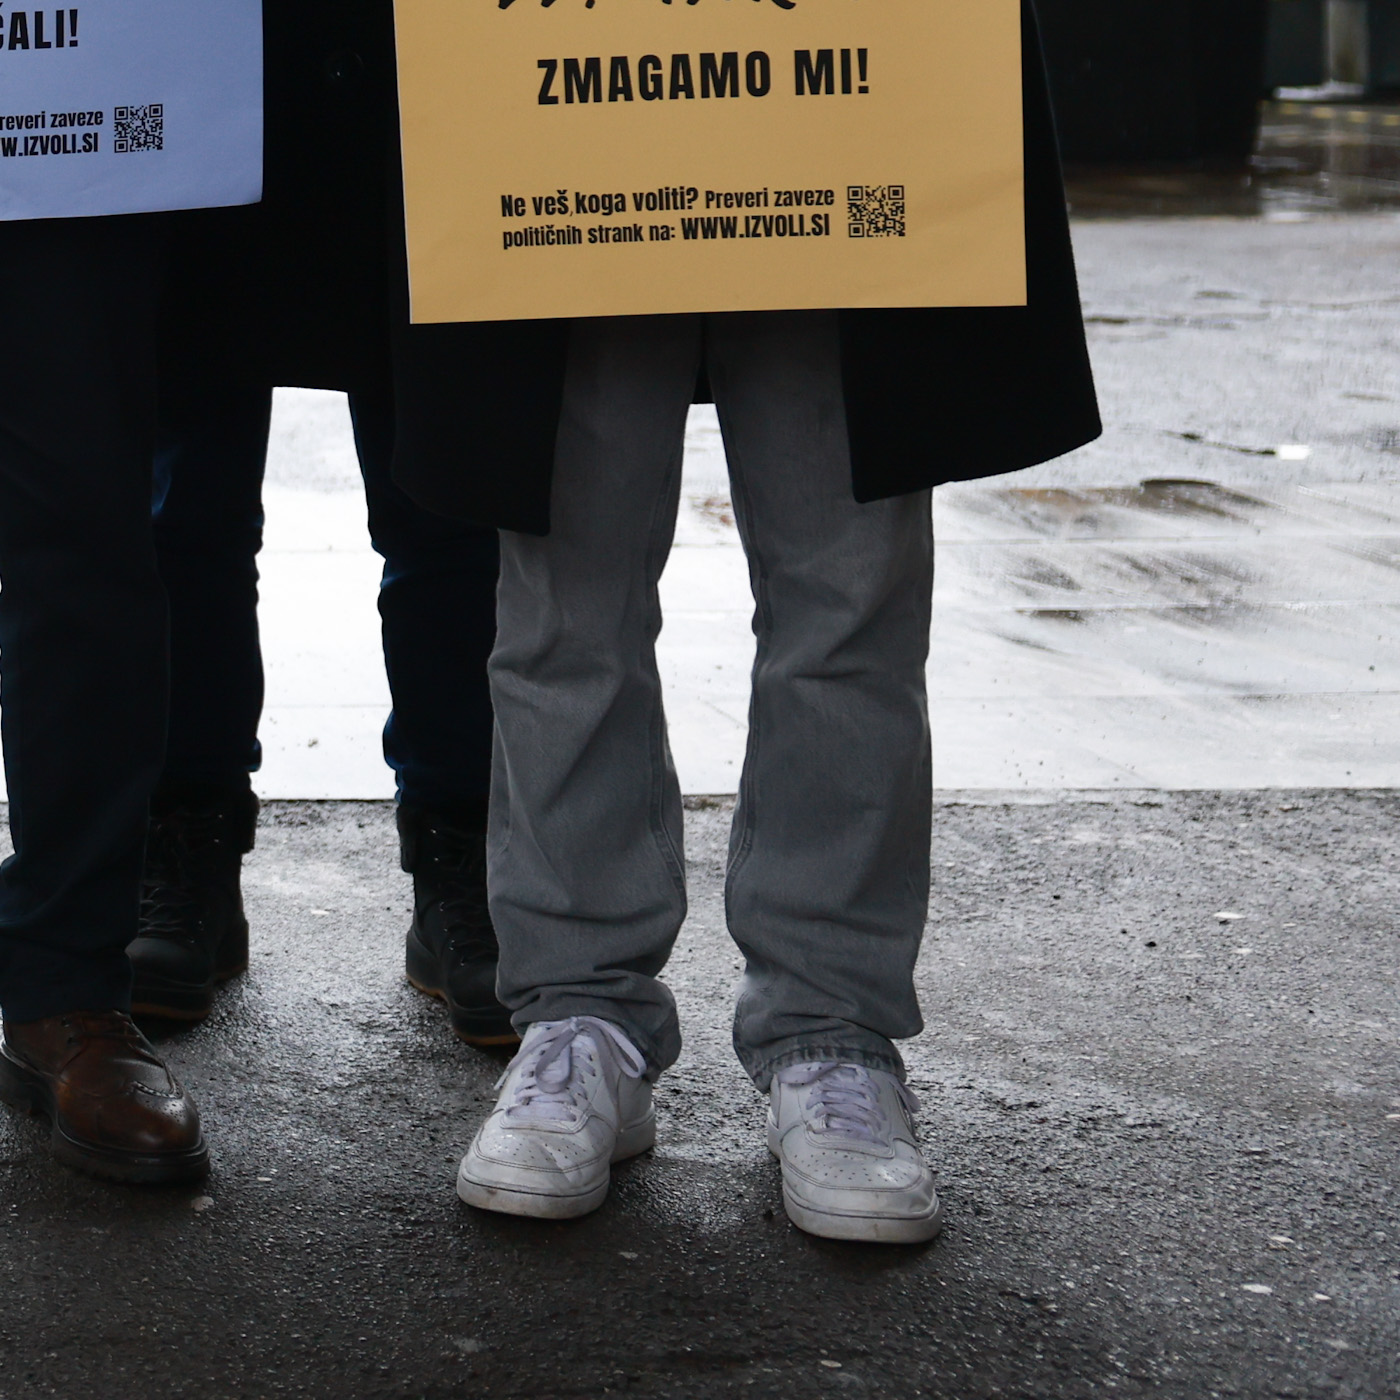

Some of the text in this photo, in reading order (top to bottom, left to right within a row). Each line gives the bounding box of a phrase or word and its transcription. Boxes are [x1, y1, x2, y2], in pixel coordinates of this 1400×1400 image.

[537, 48, 869, 105] ZMAGAMO MI!
[51, 111, 103, 128] zaveze
[501, 195, 526, 217] Ne
[575, 192, 626, 216] koga
[633, 186, 698, 211] voliti?
[705, 188, 768, 209] Preveri
[774, 190, 834, 207] zaveze
[503, 214, 829, 250] političnih strank na: WWW.IZVOLI.SI
